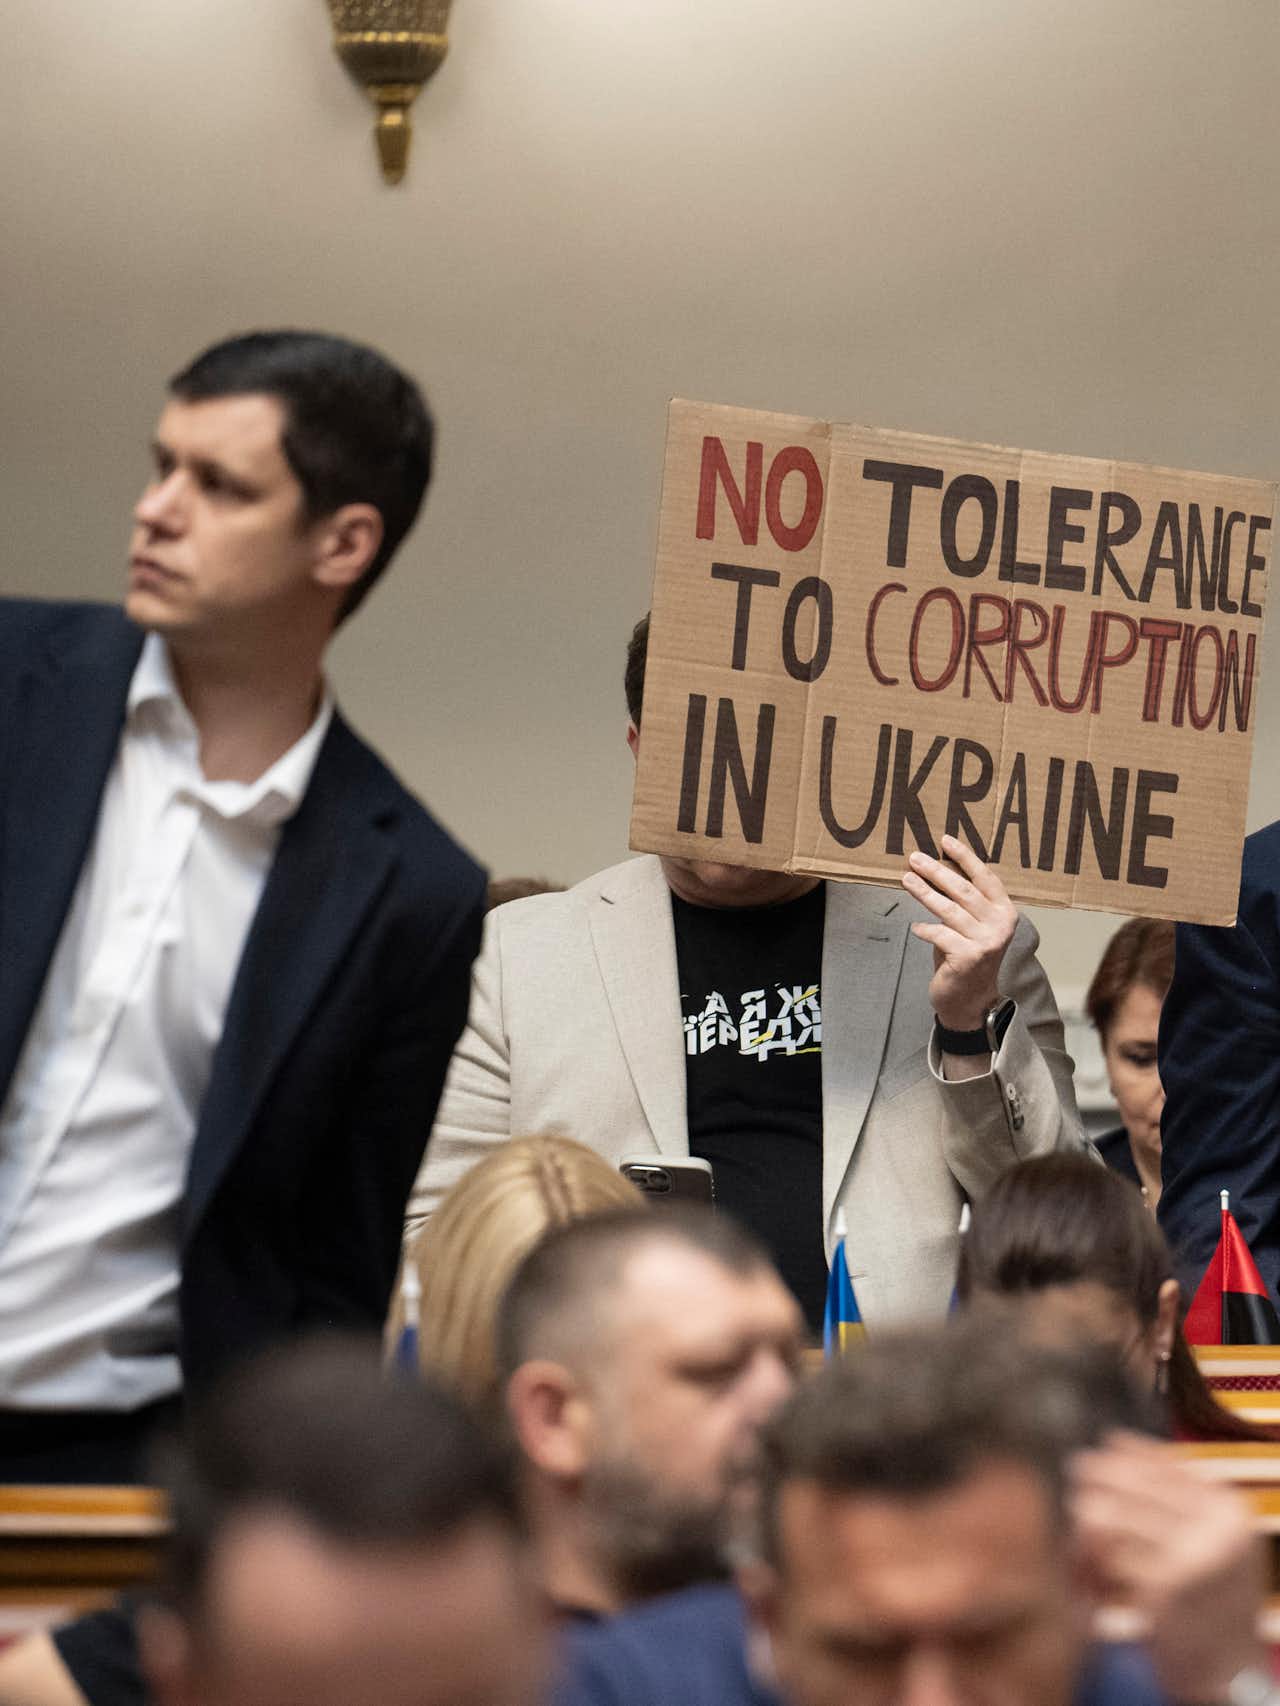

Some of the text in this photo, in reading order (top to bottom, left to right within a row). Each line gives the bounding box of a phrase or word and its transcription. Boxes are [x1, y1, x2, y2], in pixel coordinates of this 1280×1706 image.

[695, 435, 1273, 618] NO TOLERANCE
[711, 562, 1257, 733] TO CORRUPTION
[676, 692, 1180, 890] IN UKRAINE
